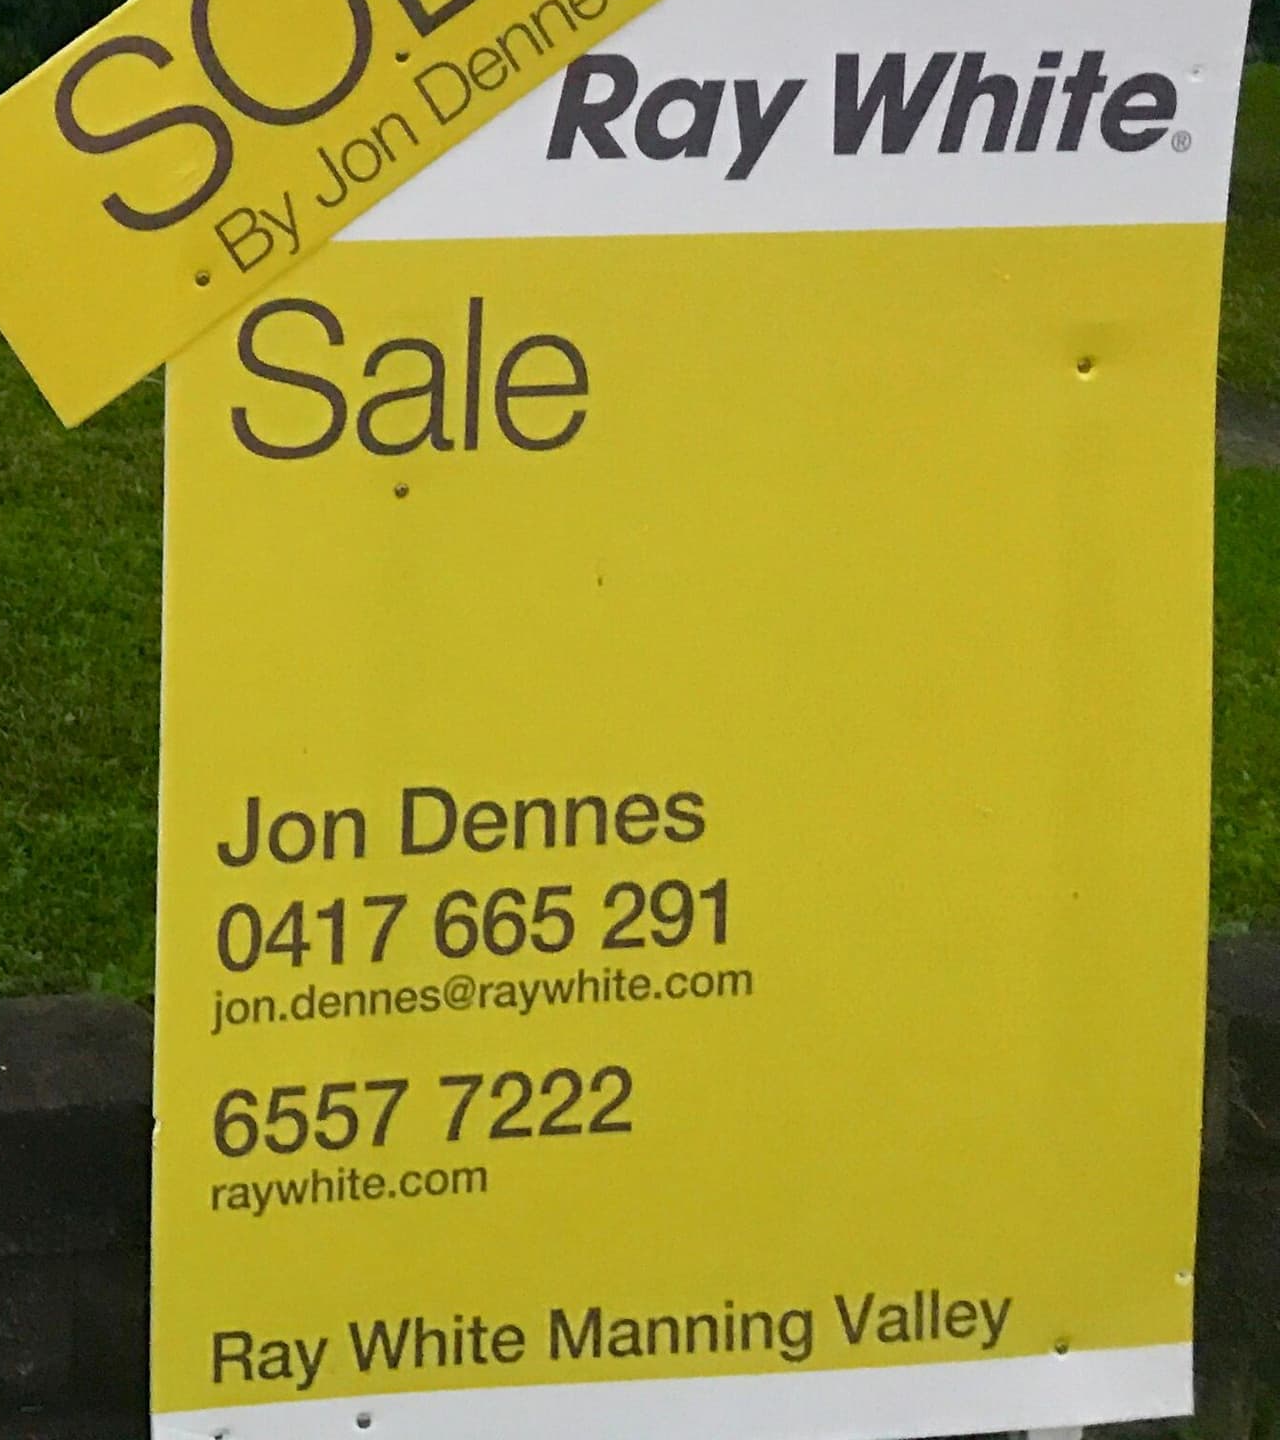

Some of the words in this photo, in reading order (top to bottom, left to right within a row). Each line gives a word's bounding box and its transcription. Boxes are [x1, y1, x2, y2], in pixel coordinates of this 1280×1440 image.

[546, 53, 808, 180] Ray
[214, 191, 300, 274] By
[315, 112, 419, 208] Jon
[230, 297, 590, 460] Sale
[216, 797, 366, 867] Jon
[400, 787, 706, 855] Dennes
[216, 895, 408, 972] 0417
[434, 885, 575, 958] 665
[601, 878, 729, 949] 291
[211, 966, 754, 1035] jon.dennes@raywhite.com
[213, 1079, 409, 1158] 6557
[439, 1065, 633, 1141] 7222
[211, 1164, 488, 1217] raywhite.com
[211, 1331, 329, 1391] Ray
[348, 1315, 526, 1372] White
[549, 1298, 814, 1364] Manning
[834, 1289, 1013, 1352] Valley
